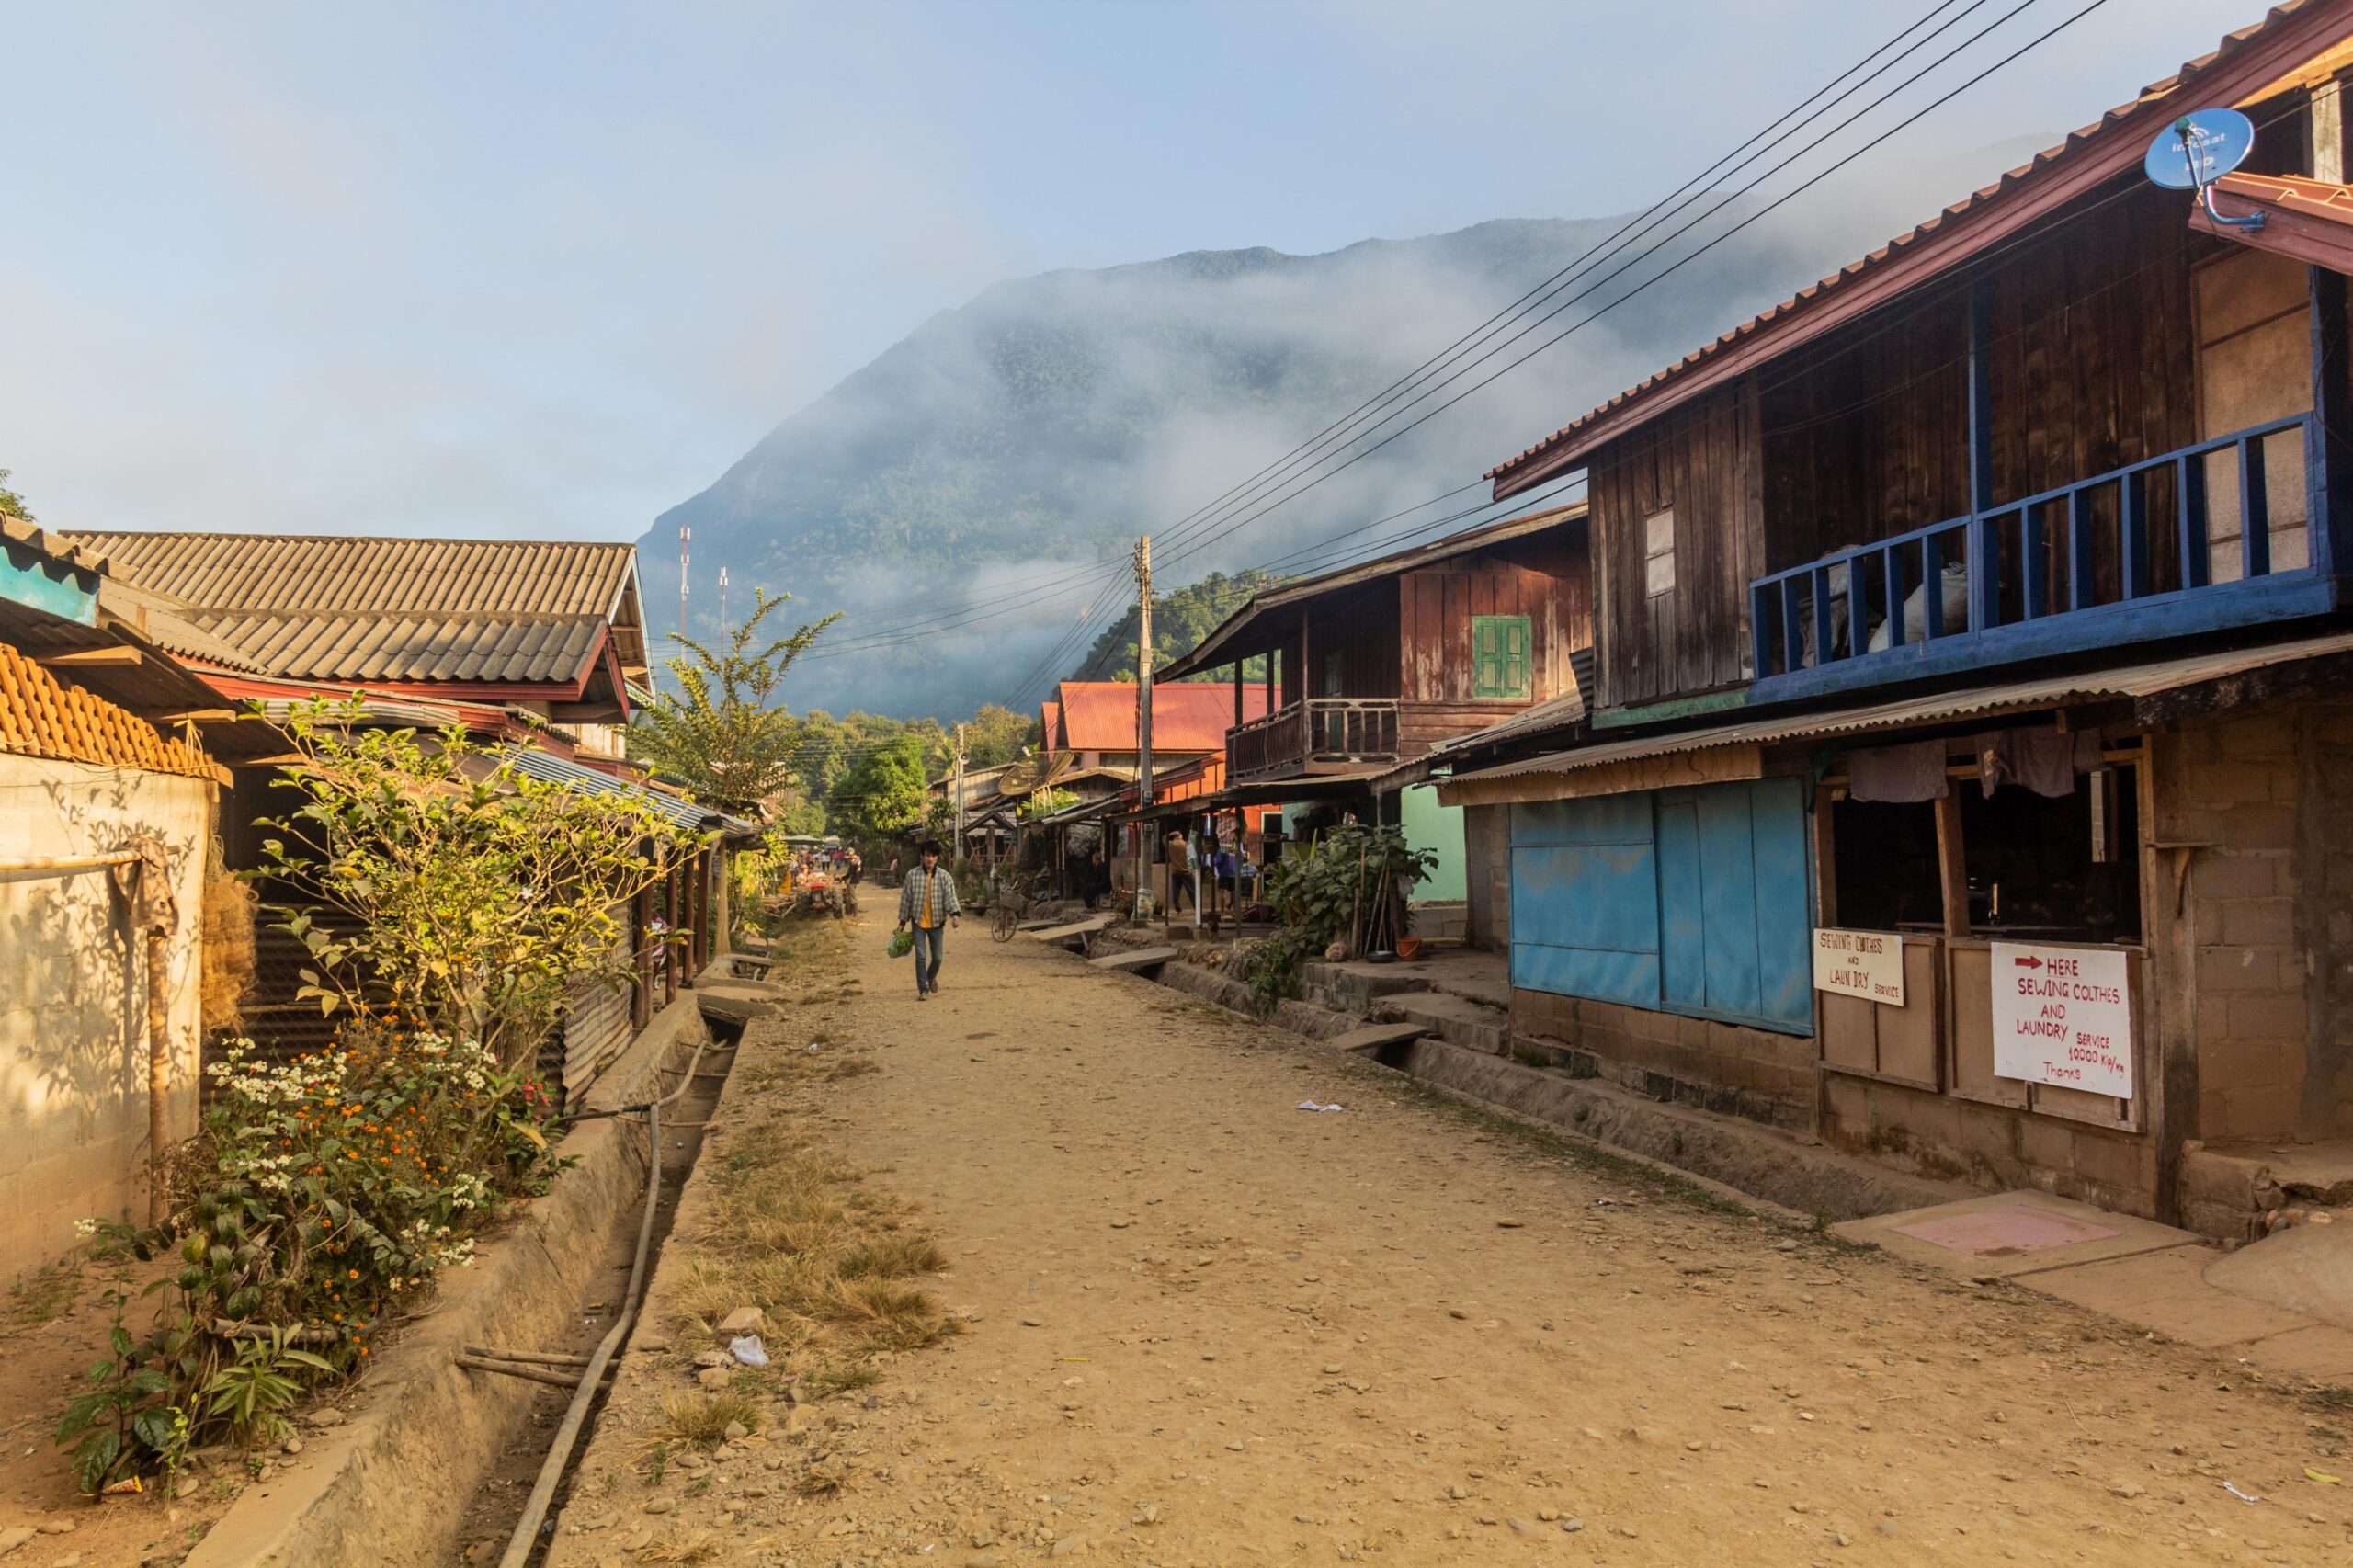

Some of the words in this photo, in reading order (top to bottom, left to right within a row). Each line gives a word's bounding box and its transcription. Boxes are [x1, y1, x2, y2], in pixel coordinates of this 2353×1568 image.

[1820, 932, 1851, 950] SEWING
[1847, 956, 1859, 965] AND
[2047, 958, 2079, 977] HERE
[1874, 983, 1899, 998] SERVICE
[2018, 977, 2069, 998] SEWING
[2073, 983, 2120, 1004] COLTHES
[2040, 1004, 2066, 1019] AND
[2017, 1019, 2068, 1041] LAUNDRY
[2076, 1031, 2109, 1049] SERVICE
[2042, 1061, 2081, 1080] Thanks
